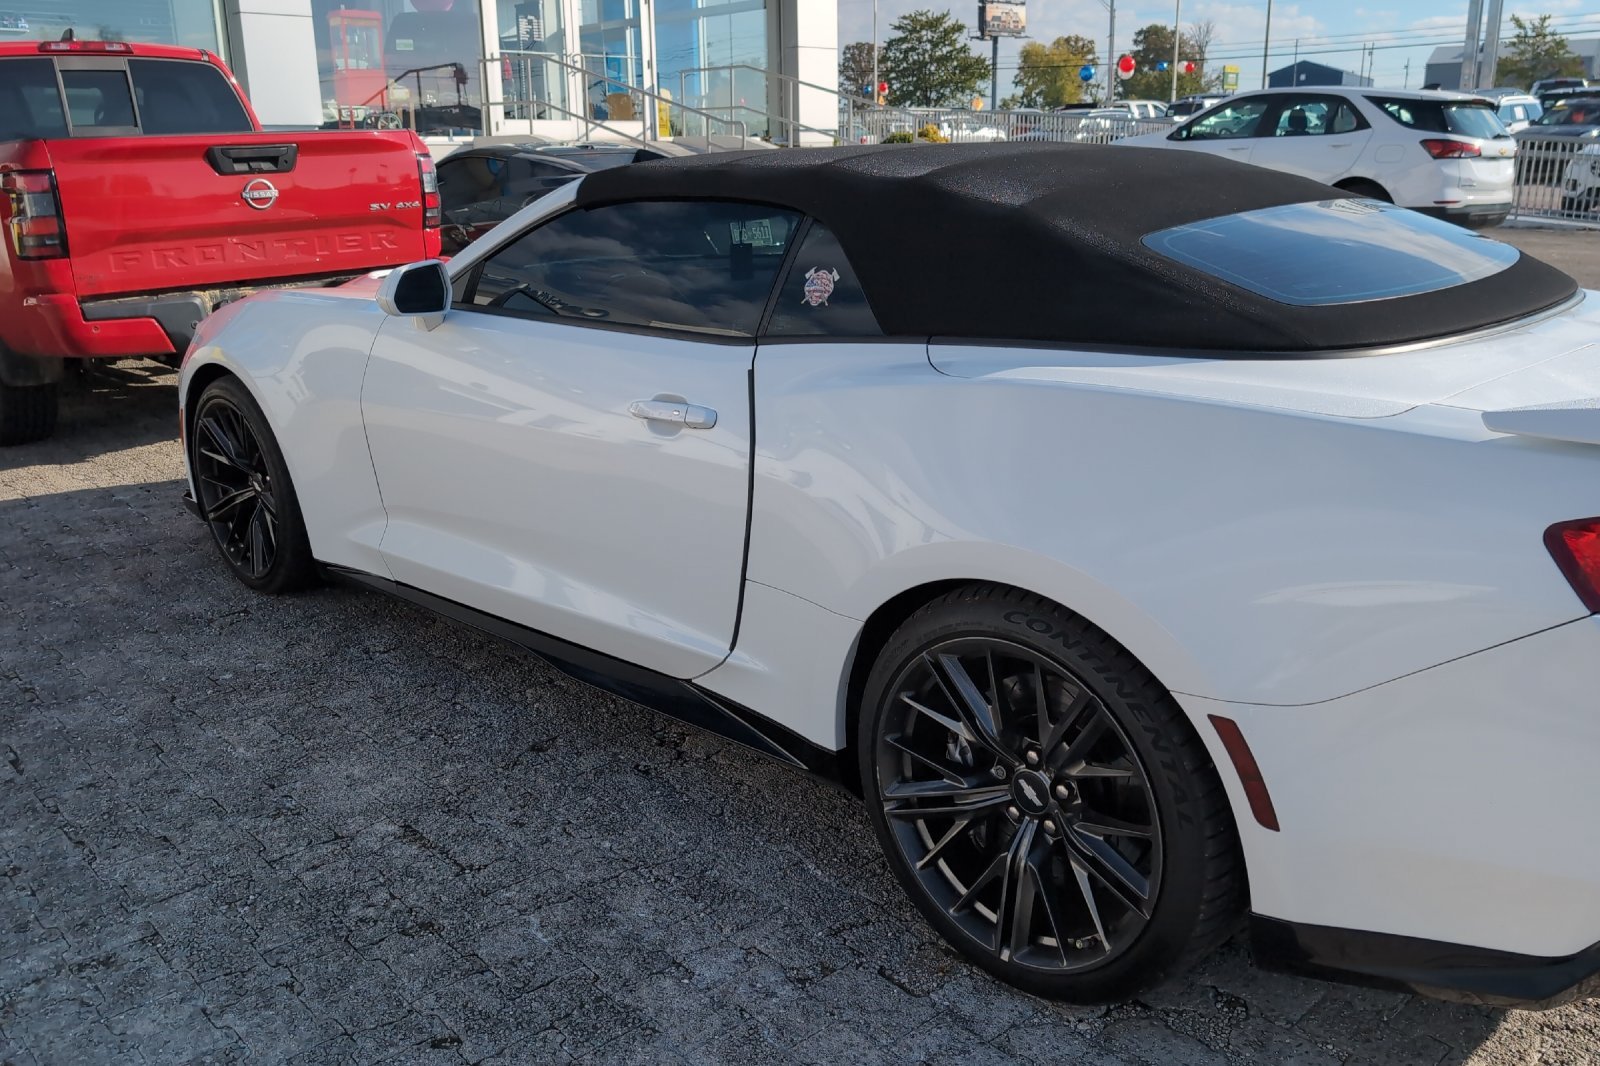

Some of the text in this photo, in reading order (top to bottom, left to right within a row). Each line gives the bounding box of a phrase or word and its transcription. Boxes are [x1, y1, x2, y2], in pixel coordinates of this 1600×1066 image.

[242, 190, 279, 199] NISSAN
[369, 202, 391, 211] SV
[752, 226, 769, 239] 5611
[110, 230, 398, 272] FRONTIER
[1004, 611, 1194, 829] CONTINENTAL
